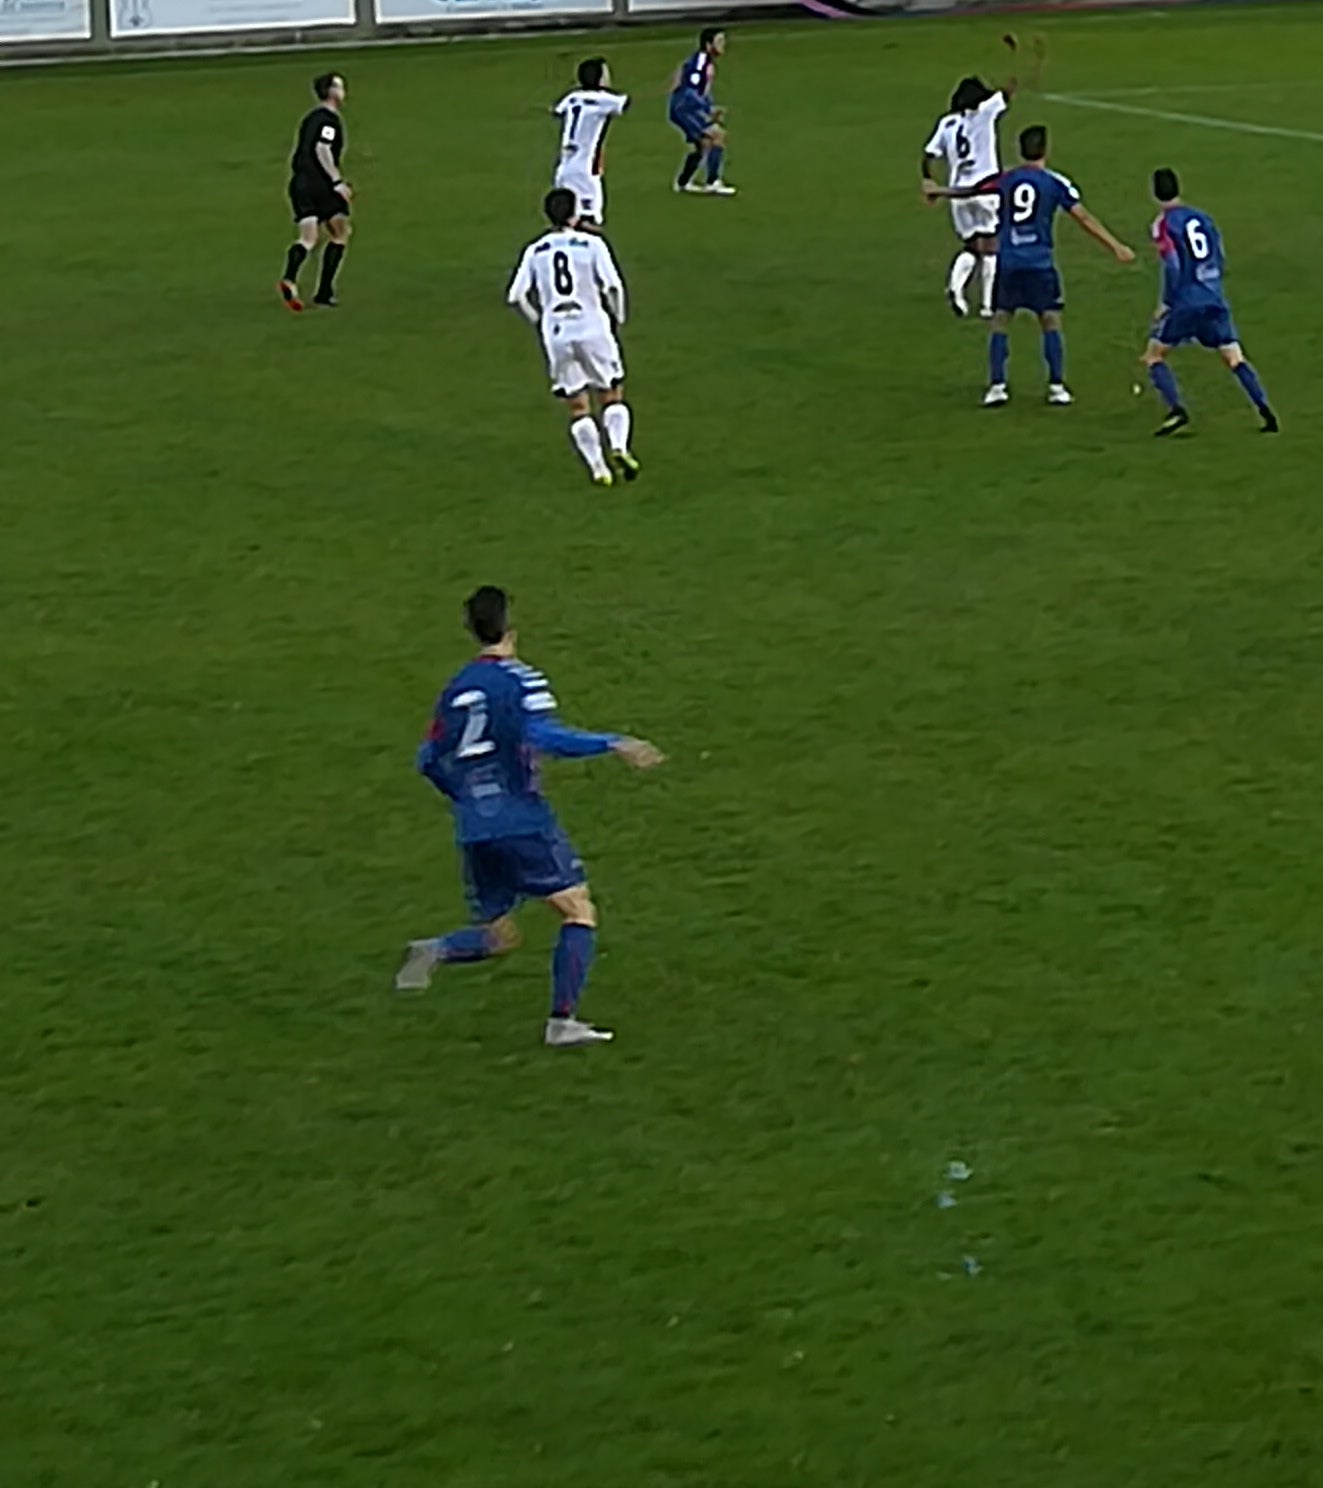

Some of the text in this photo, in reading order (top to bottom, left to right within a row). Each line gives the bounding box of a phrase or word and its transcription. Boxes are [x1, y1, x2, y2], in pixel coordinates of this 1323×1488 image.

[956, 125, 970, 159] 6
[1013, 183, 1036, 223] 9
[1186, 218, 1209, 259] 6
[553, 250, 574, 297] 8
[451, 689, 497, 759] 2
